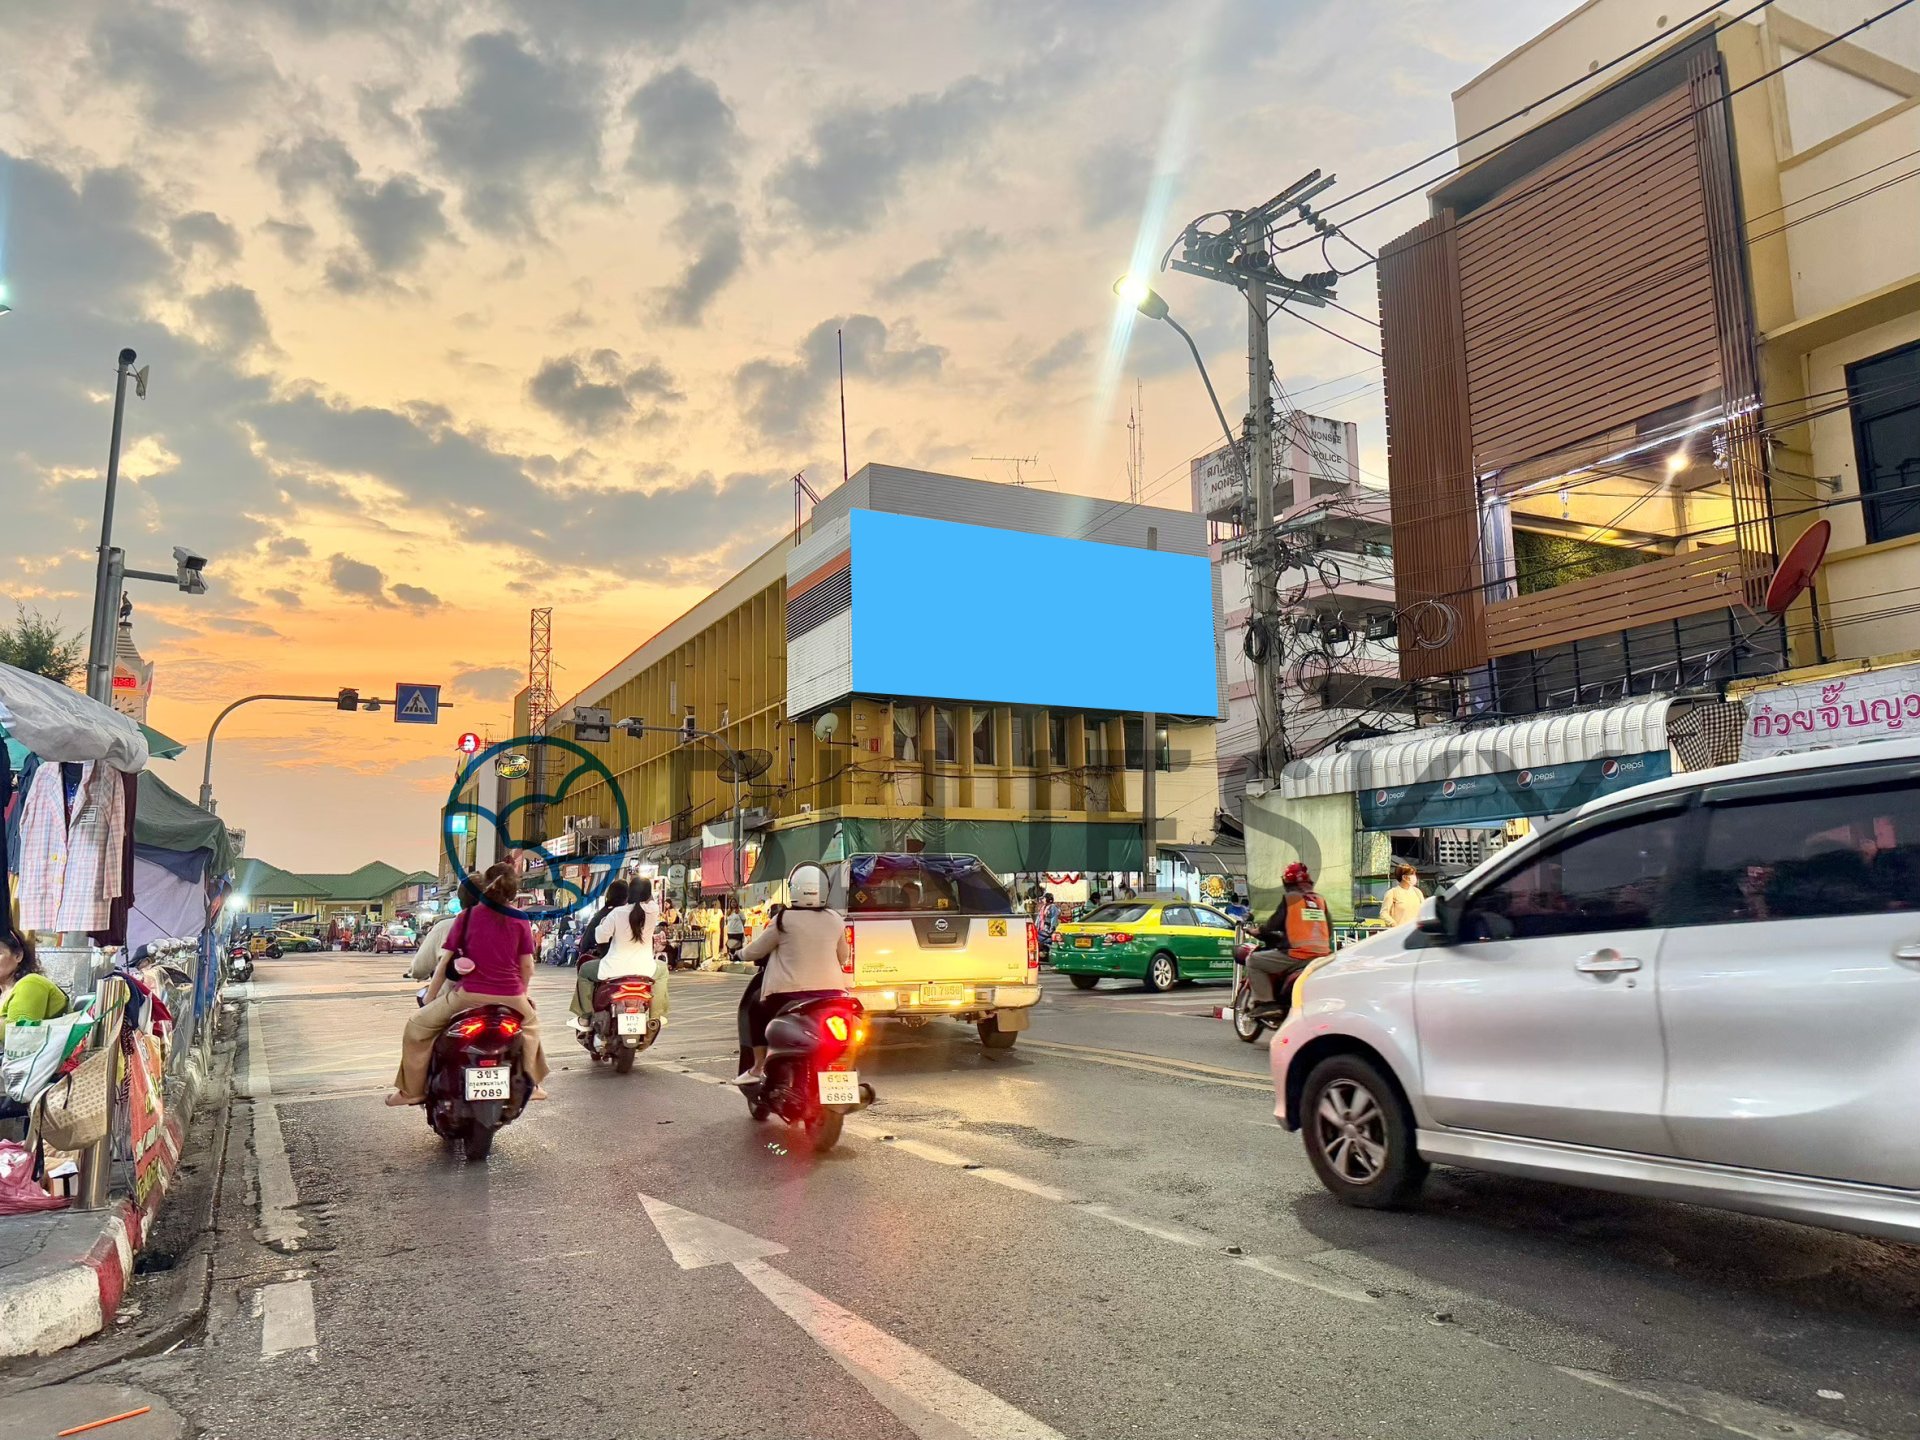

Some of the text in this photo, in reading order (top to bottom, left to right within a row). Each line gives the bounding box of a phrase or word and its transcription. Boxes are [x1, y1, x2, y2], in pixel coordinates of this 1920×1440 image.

[1313, 450, 1342, 464] POLICE
[1620, 760, 1645, 772] pepsi
[1533, 771, 1556, 783] pepsi
[1457, 781, 1477, 793] pepsi
[1388, 790, 1406, 801] pepsi
[473, 1089, 503, 1098] 7089
[826, 1092, 854, 1102] 6869
